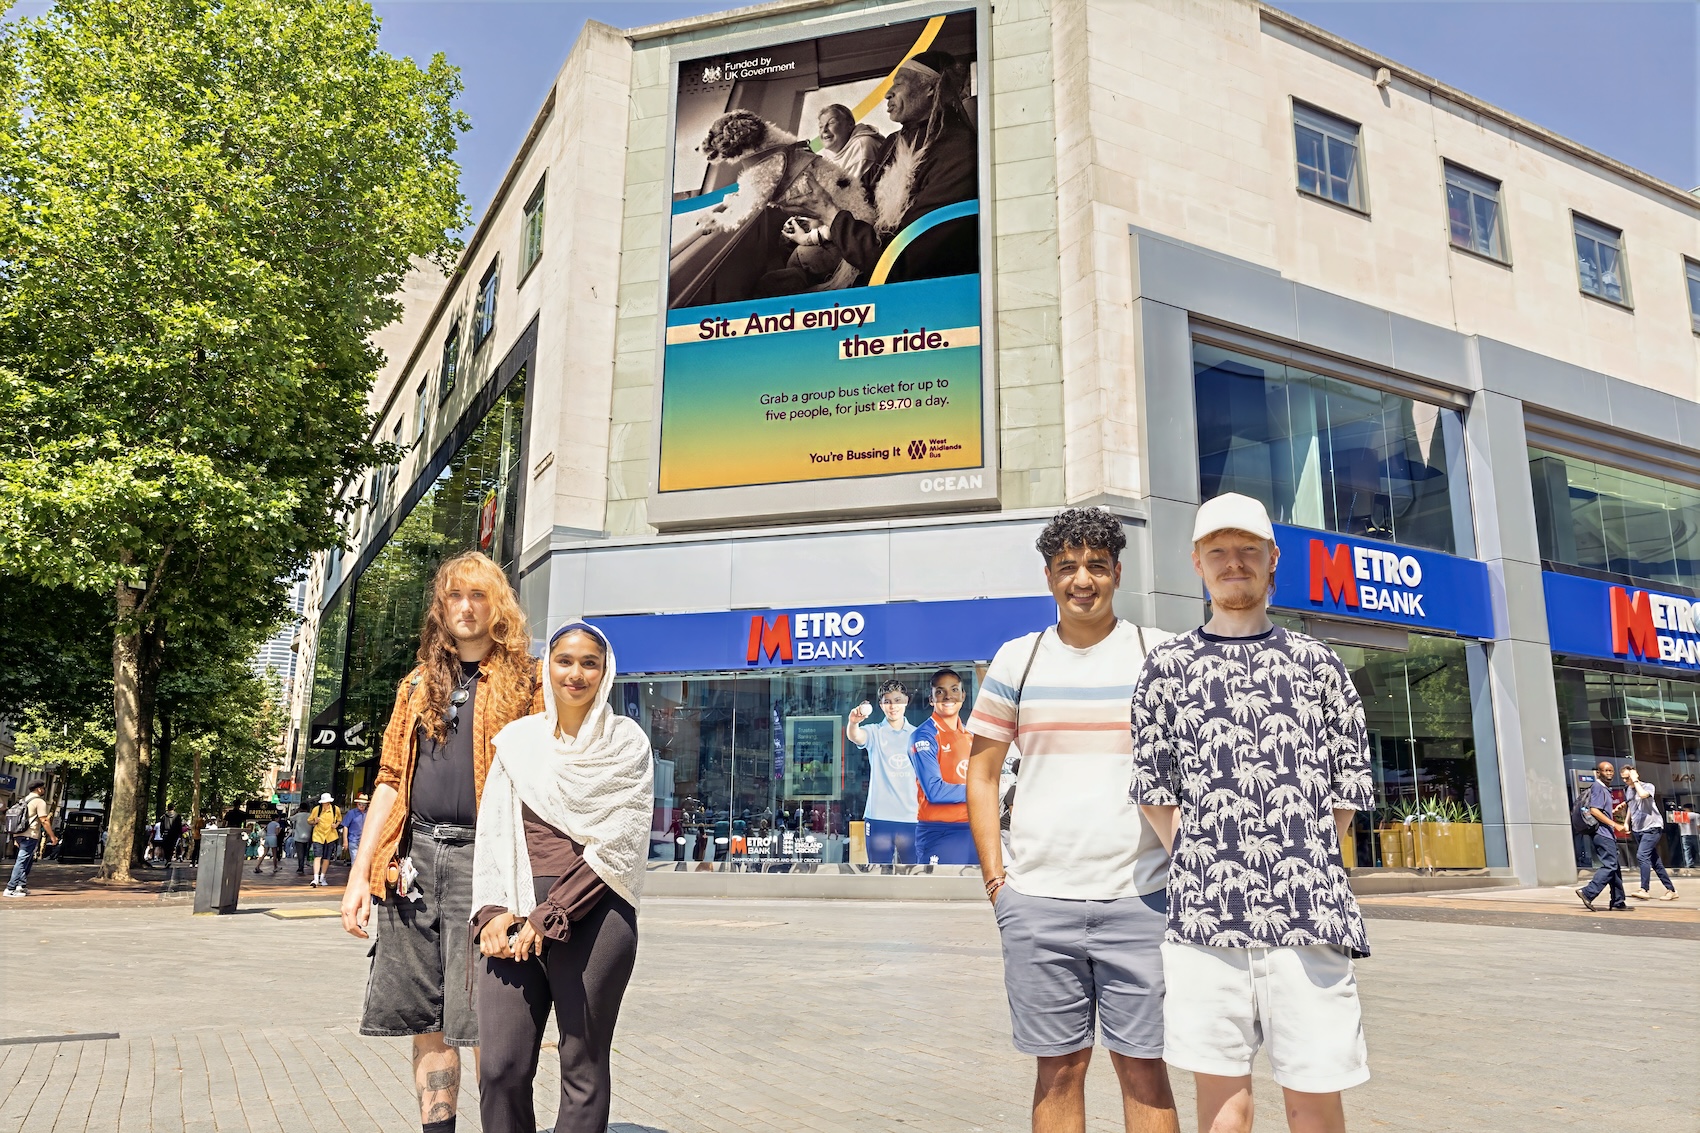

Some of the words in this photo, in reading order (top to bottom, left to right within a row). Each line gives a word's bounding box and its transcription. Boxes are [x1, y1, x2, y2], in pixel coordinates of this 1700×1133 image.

[724, 71, 738, 80] UK
[740, 61, 795, 78] Government
[725, 58, 758, 71] Funded
[760, 57, 772, 66] by
[699, 316, 737, 340] Sit.
[744, 308, 795, 335] And
[802, 302, 872, 331] enjoy
[842, 334, 885, 358] the
[893, 327, 950, 353] ride.
[760, 392, 789, 405] Grab
[801, 390, 836, 403] group
[838, 387, 860, 398] bus
[862, 382, 895, 396] ticket
[898, 380, 915, 391] for
[917, 379, 933, 391] up
[936, 378, 949, 388] to
[765, 409, 787, 421] five
[789, 405, 832, 421] people,
[835, 403, 852, 414] for
[854, 401, 876, 415] just
[878, 397, 912, 411] £9.70
[915, 399, 922, 407] a
[925, 395, 950, 408] day.
[809, 451, 844, 463] You're
[847, 448, 890, 461] Bussing
[893, 446, 901, 457] It
[929, 443, 962, 451] Midlands
[920, 474, 983, 493] OCEAN
[1309, 539, 1422, 607] METRO
[1360, 585, 1426, 617] BANK
[746, 611, 865, 662] METRO
[797, 640, 865, 660] BANK
[312, 730, 337, 745] JD
[731, 836, 772, 854] METRO
[747, 847, 771, 855] BANK
